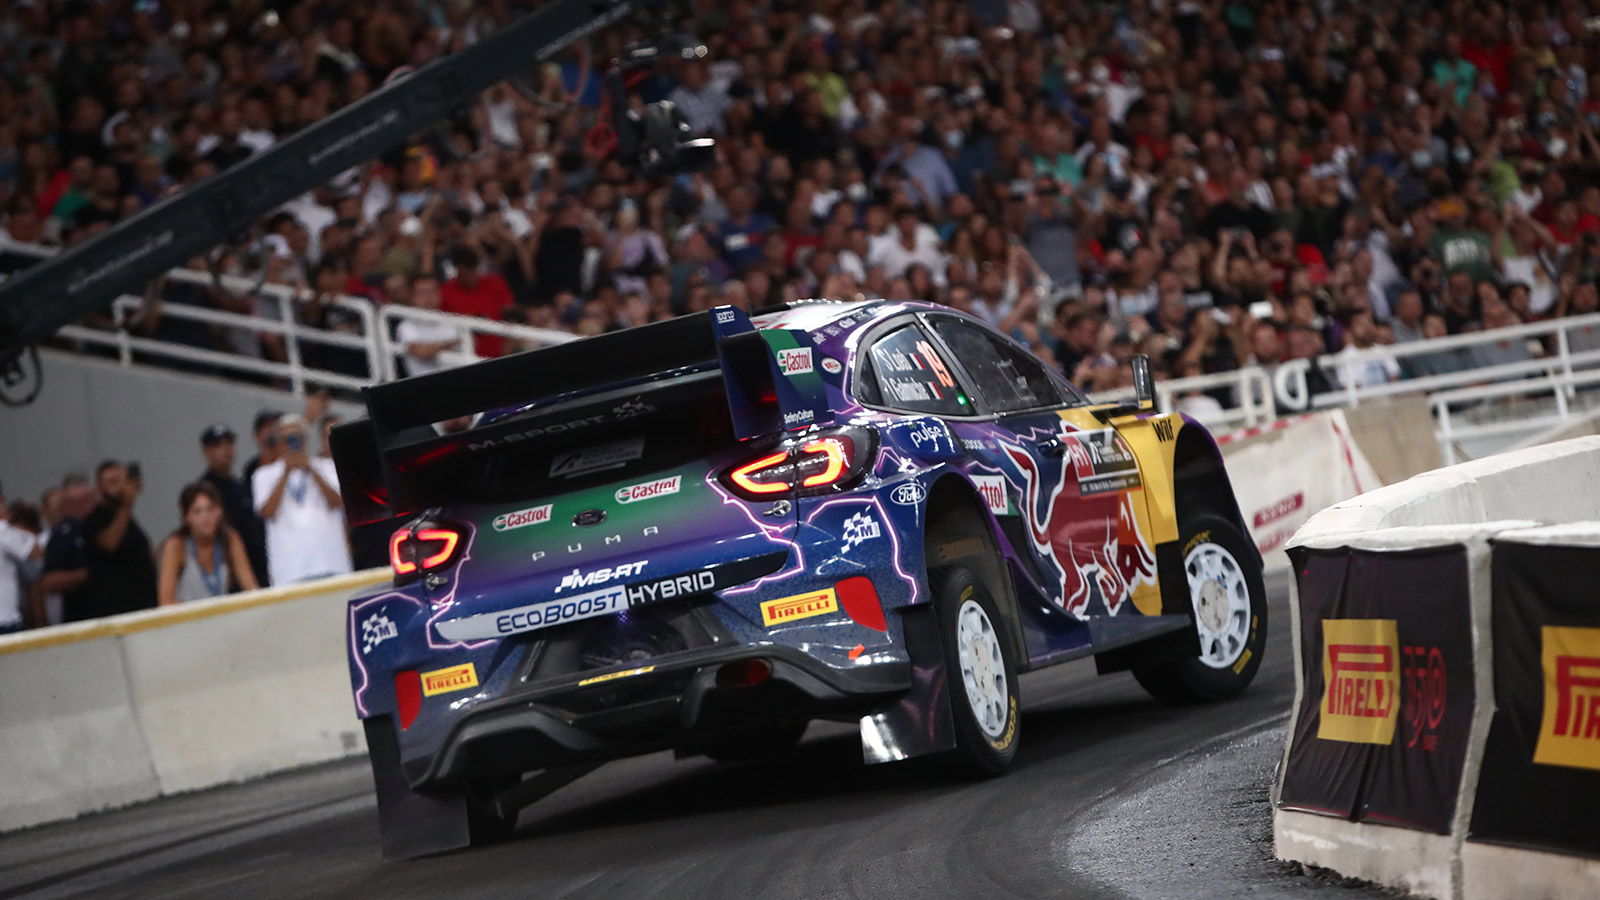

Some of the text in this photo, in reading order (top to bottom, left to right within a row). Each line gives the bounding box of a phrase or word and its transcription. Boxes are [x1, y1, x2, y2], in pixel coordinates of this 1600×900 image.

[786, 351, 812, 372] Castrol
[915, 340, 955, 388] 19
[784, 409, 814, 424] SafetyCulture
[467, 414, 604, 452] M-SPORT
[910, 421, 943, 448] pulse
[1152, 418, 1175, 443] Wilf
[632, 478, 676, 500] Castrol
[898, 484, 922, 503] Ford
[507, 506, 548, 528] Castrol
[531, 525, 659, 562] PUMA
[861, 525, 873, 537] M
[628, 570, 716, 605] HYBRID
[767, 594, 830, 620] PIRELLI
[425, 669, 471, 691] PIRELLI
[1328, 644, 1393, 718] PIRELLI
